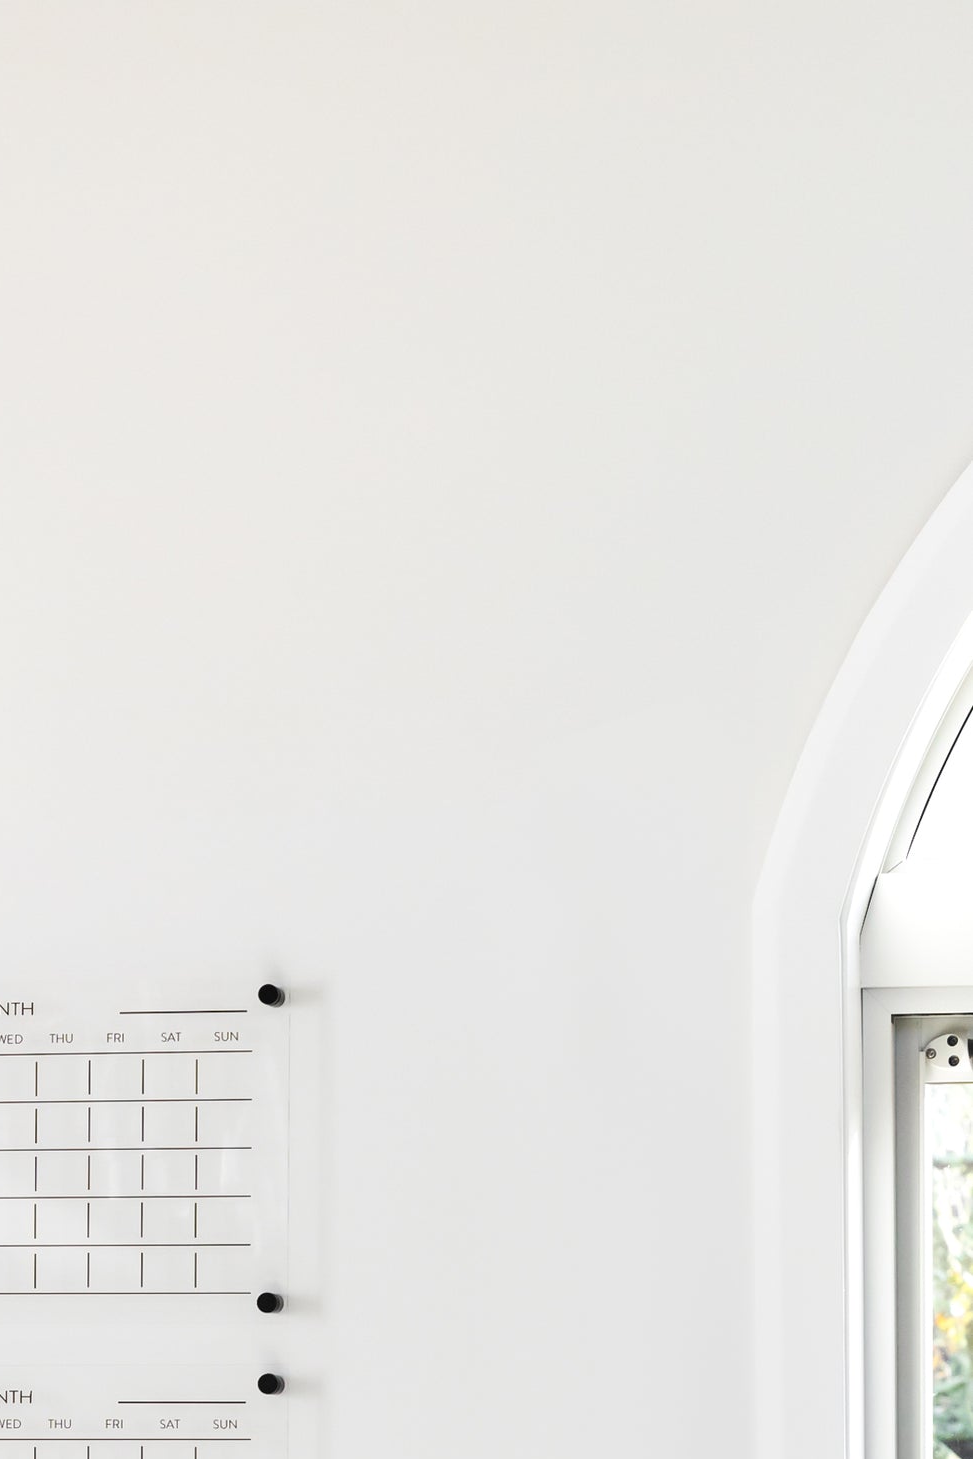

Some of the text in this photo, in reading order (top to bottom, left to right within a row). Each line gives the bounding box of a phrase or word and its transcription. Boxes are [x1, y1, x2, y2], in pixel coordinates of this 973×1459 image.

[49, 1033, 74, 1044] THU
[106, 1032, 125, 1043] FRI
[160, 1031, 182, 1043] SAT
[213, 1031, 239, 1042] SUN
[47, 1418, 72, 1430] THU
[105, 1418, 124, 1429] FRI
[159, 1418, 181, 1430] SAT
[212, 1418, 238, 1430] SUN
